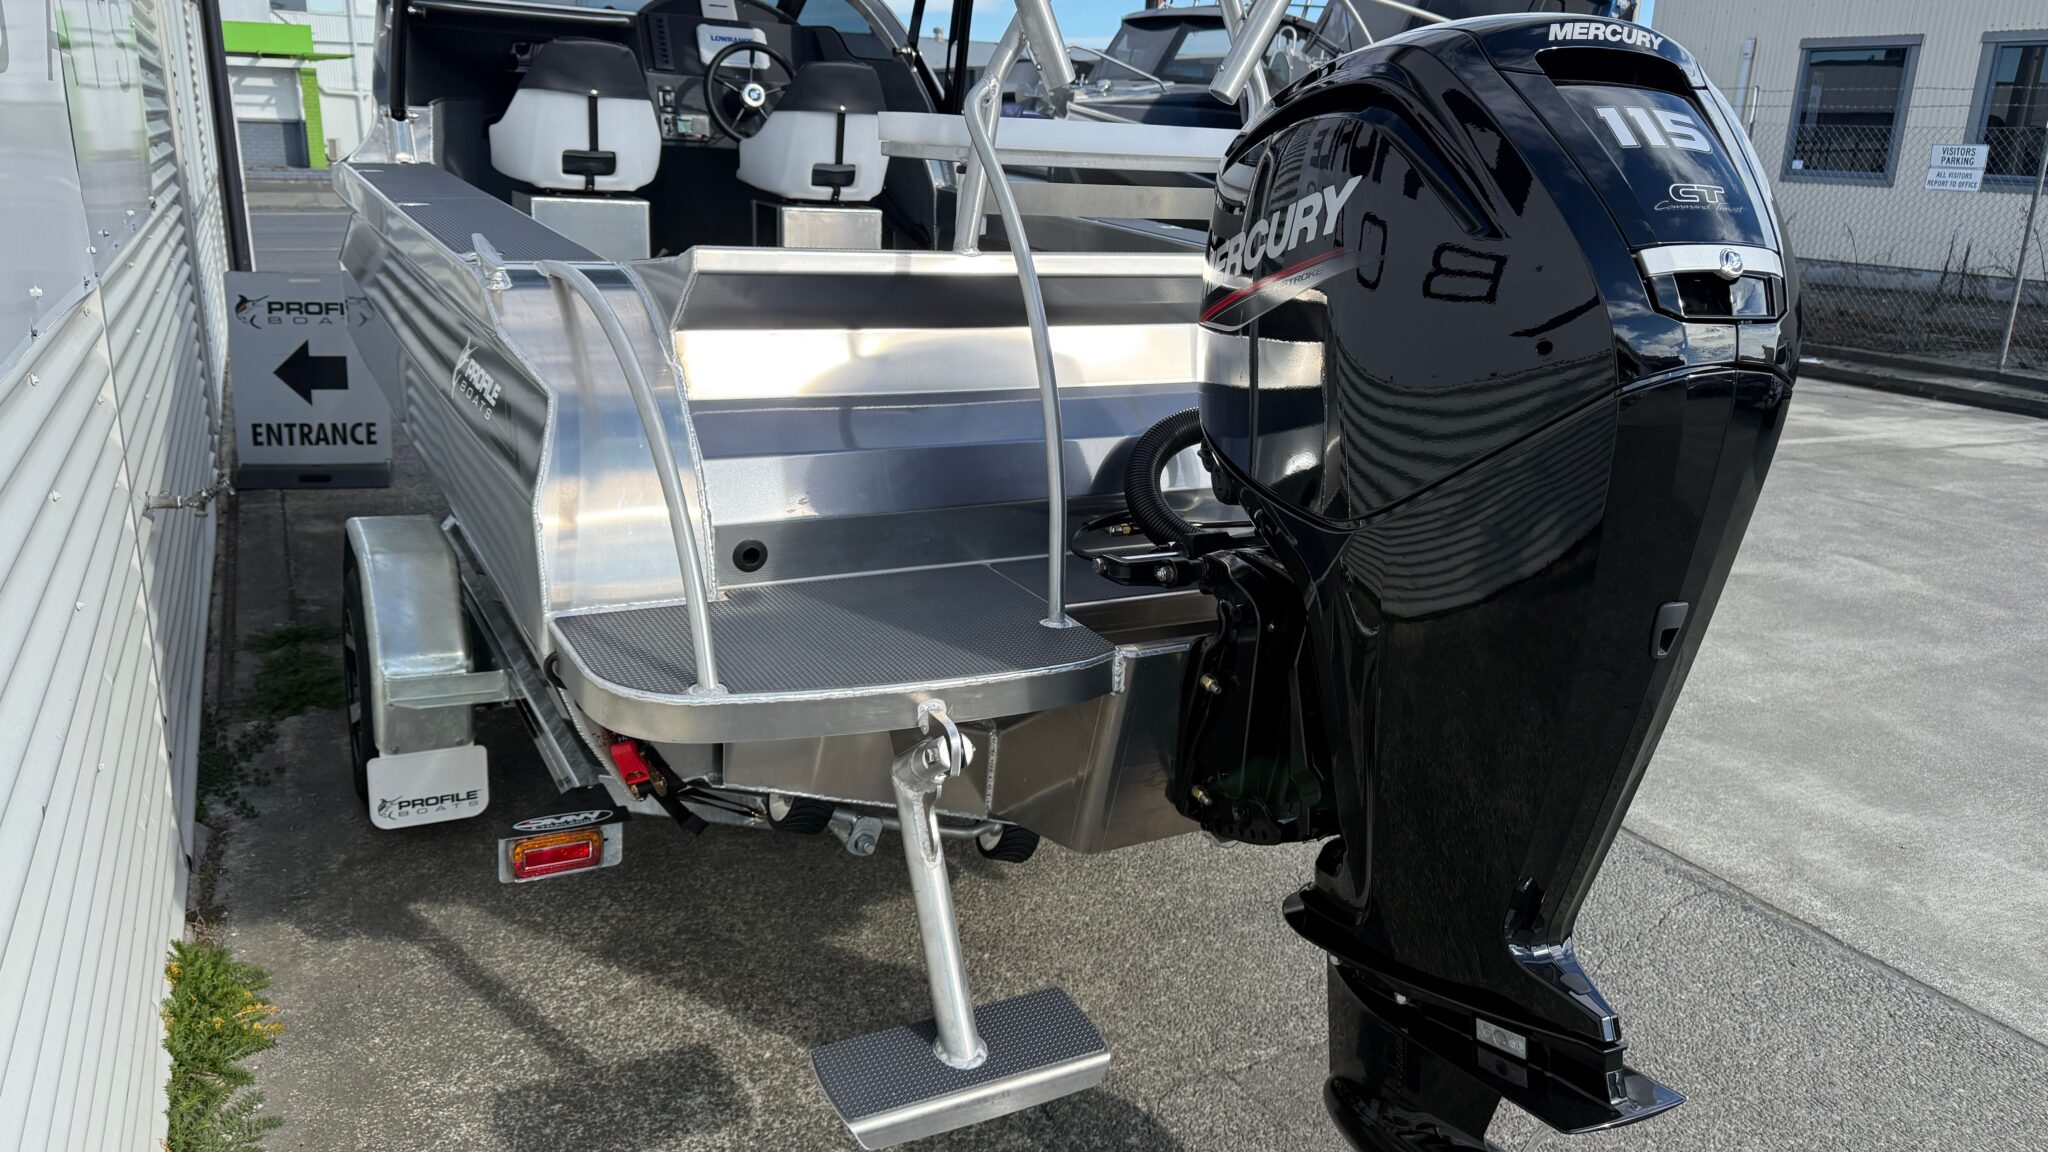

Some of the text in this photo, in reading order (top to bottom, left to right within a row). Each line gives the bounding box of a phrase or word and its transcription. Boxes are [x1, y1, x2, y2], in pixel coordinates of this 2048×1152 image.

[1548, 22, 1664, 50] MERCURY
[1594, 106, 1713, 154] 115
[1942, 147, 1976, 156] VISITORS
[1940, 156, 1975, 166] PARKING
[1936, 171, 1946, 179] ALL
[1926, 179, 1978, 189] REPORT TO OFFICE
[1654, 200, 1746, 213] Command Thrust
[266, 301, 345, 315] PROFI
[267, 316, 345, 325] BOA
[465, 358, 502, 407] PROFILE
[460, 379, 493, 420] BOATS
[251, 422, 378, 446] ENTRANCE
[398, 789, 479, 811] PROFILE
[398, 801, 479, 817] BOATS
